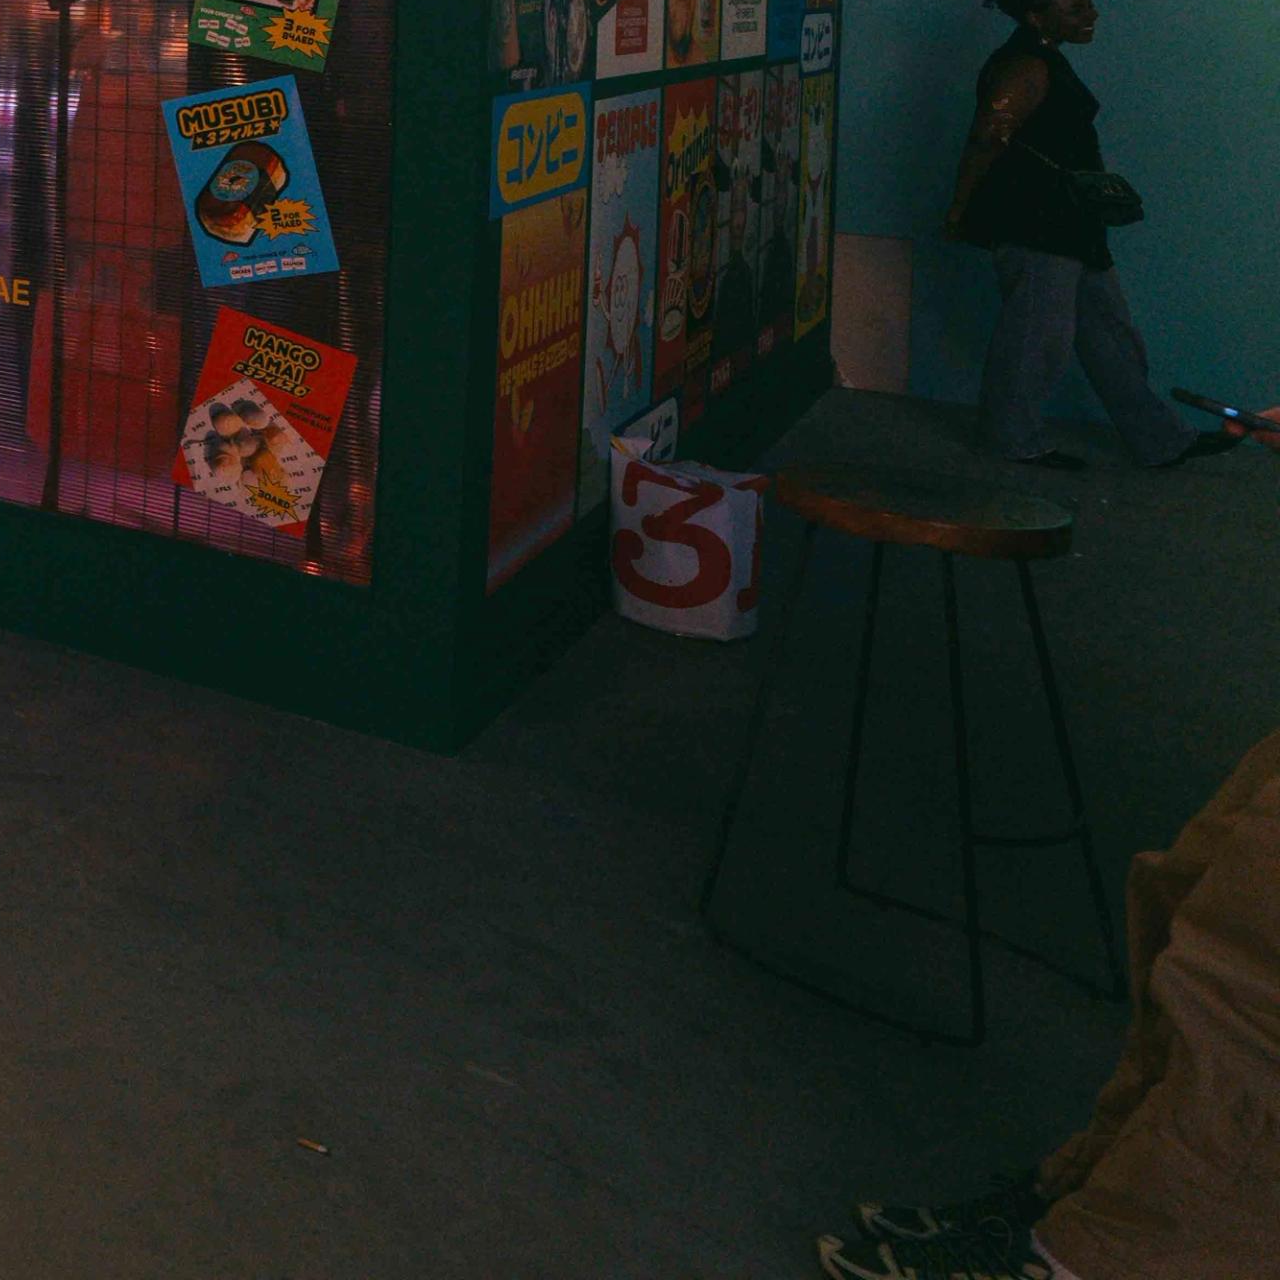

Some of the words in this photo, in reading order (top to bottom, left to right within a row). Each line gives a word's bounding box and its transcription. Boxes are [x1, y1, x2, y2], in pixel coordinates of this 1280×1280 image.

[283, 18, 294, 31] 3
[296, 25, 316, 37] FOR
[181, 92, 283, 134] MUSUBI
[597, 101, 657, 163] TEMPLE
[504, 107, 585, 187] コンビニ
[271, 208, 281, 222] 2
[283, 212, 300, 220] FOR
[246, 329, 318, 368] MANGO
[250, 352, 303, 384] AMAI
